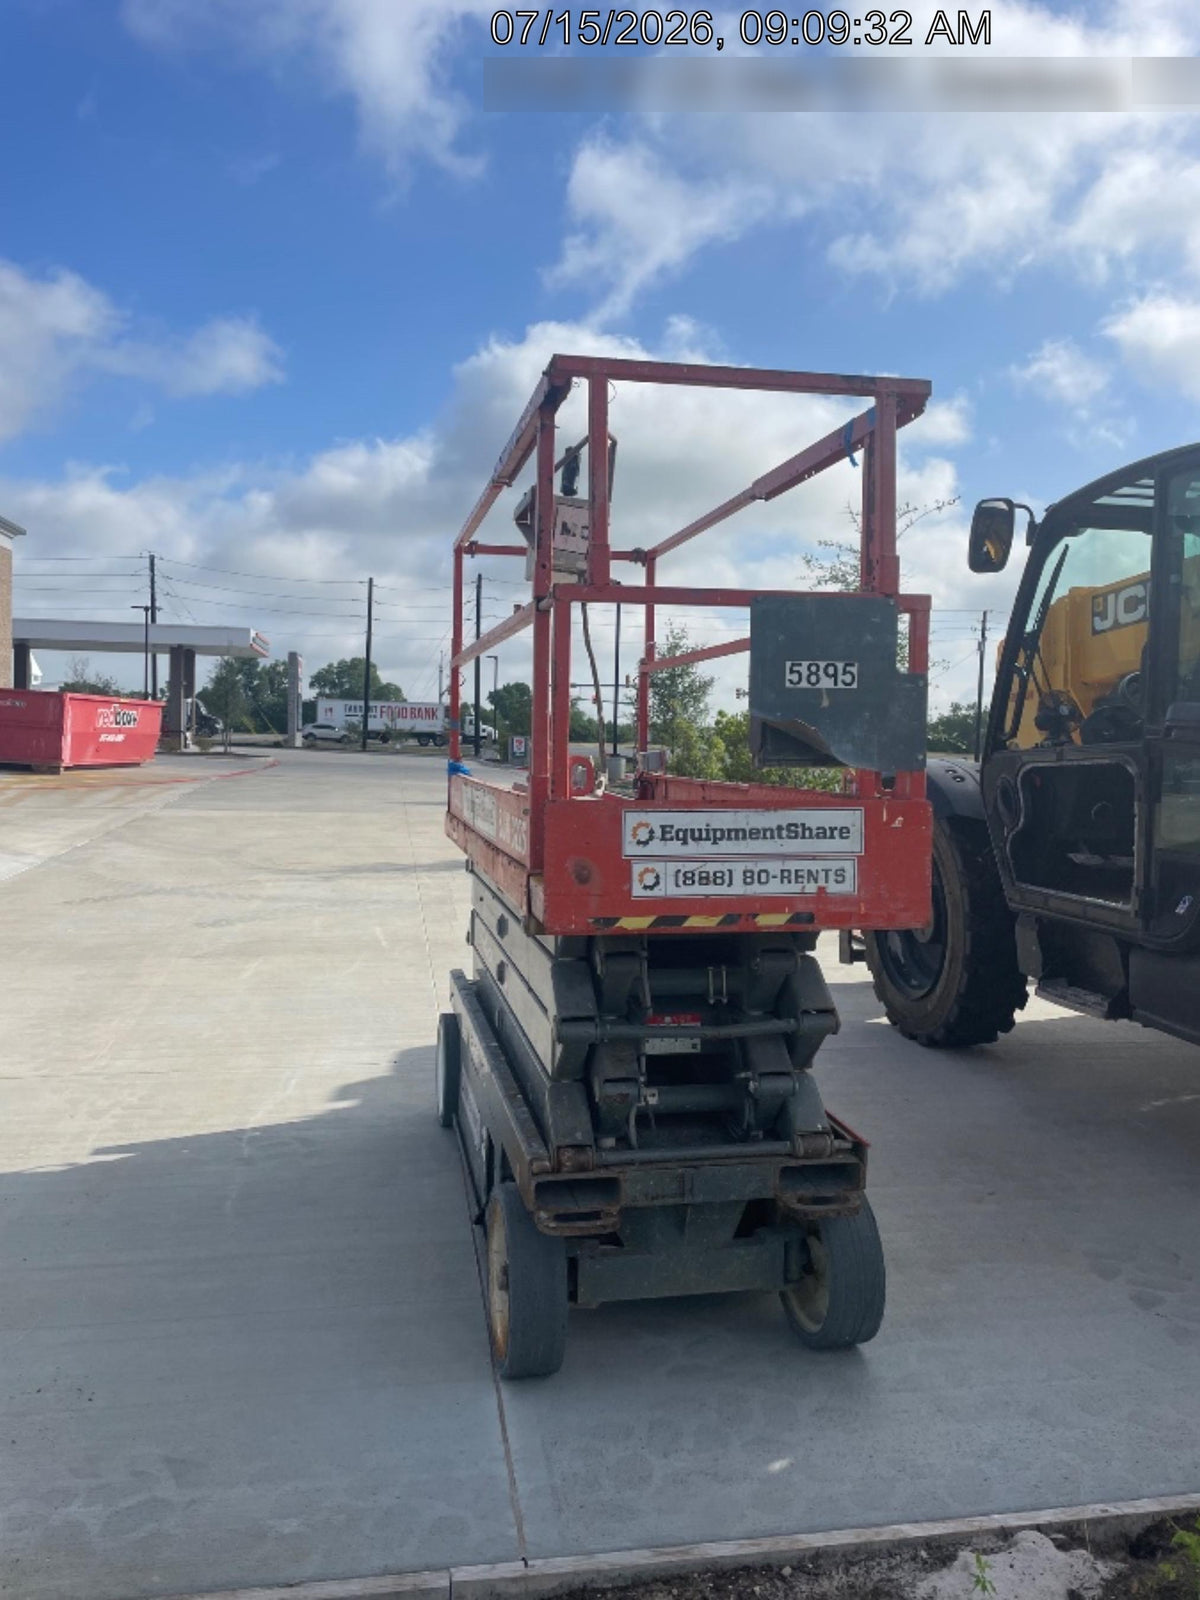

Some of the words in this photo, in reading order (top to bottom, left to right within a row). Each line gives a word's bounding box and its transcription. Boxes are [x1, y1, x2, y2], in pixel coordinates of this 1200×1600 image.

[1093, 581, 1150, 631] JC
[786, 662, 856, 687] 5895
[379, 705, 409, 719] FOOD
[410, 706, 438, 721] BANK
[658, 822, 851, 845] EquipmentShare
[674, 868, 734, 888] (888)
[742, 867, 847, 886] 80-RENTS
